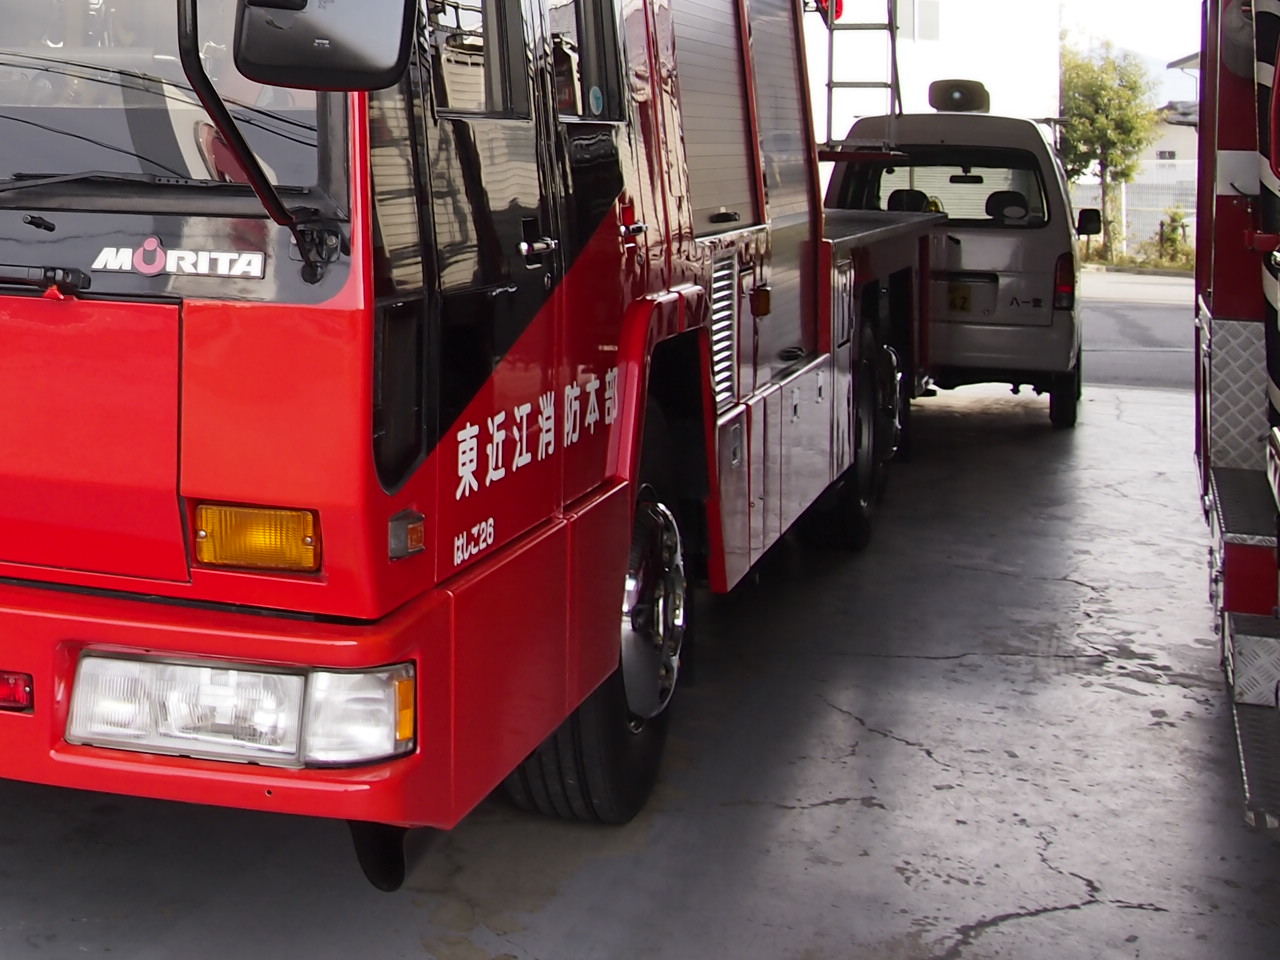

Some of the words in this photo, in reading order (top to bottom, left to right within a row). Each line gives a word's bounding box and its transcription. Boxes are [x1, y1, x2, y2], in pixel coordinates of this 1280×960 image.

[91, 237, 263, 277] MORITA
[455, 367, 618, 501] 東近江消防本部
[454, 517, 495, 567] はしご26
